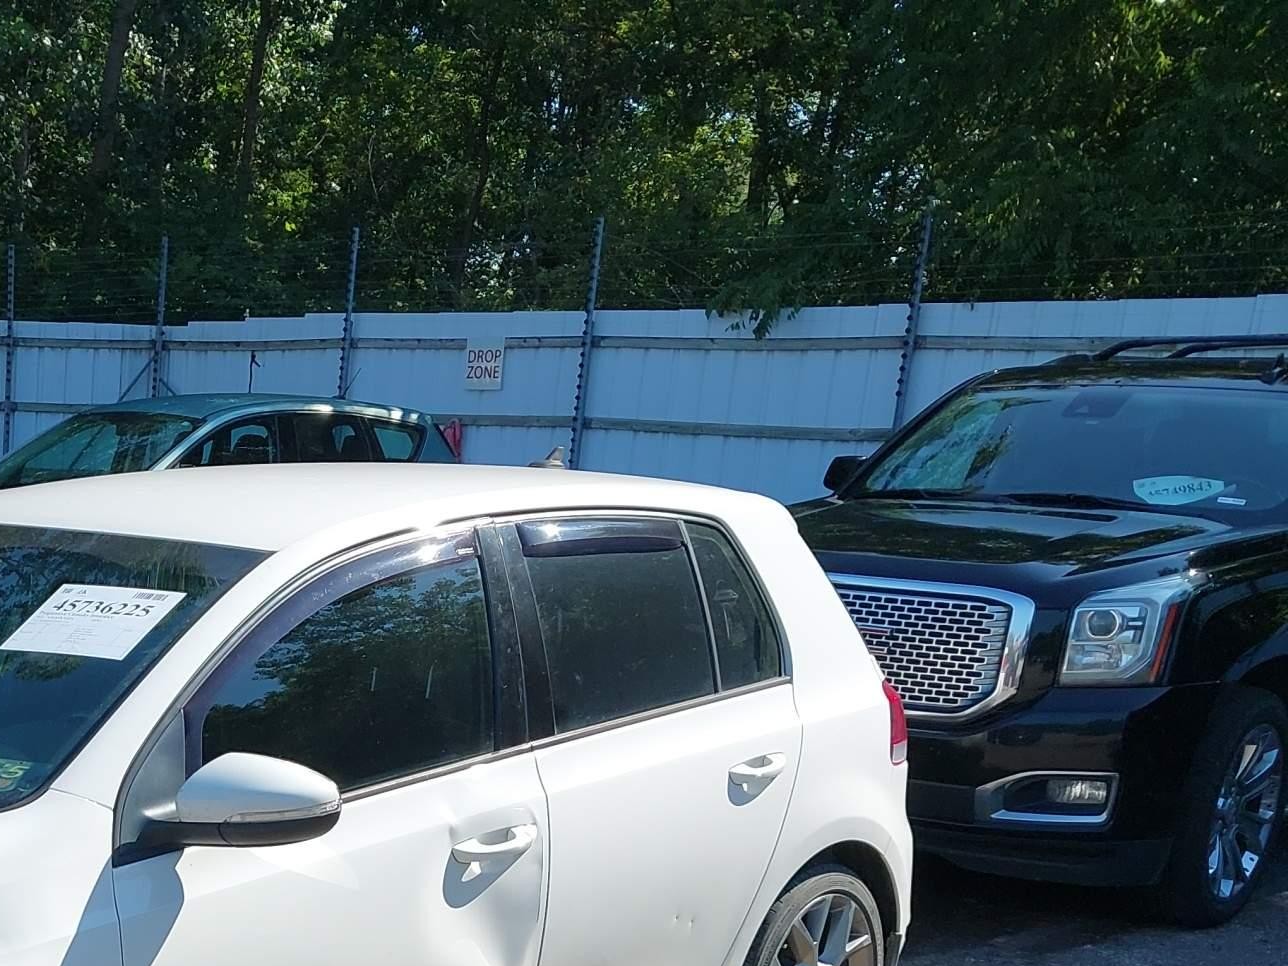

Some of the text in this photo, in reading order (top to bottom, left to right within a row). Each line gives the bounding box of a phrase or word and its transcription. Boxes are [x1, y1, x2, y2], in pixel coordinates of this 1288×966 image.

[468, 349, 502, 363] DROP
[466, 365, 500, 379] ZONE
[53, 599, 157, 617] 45736225
